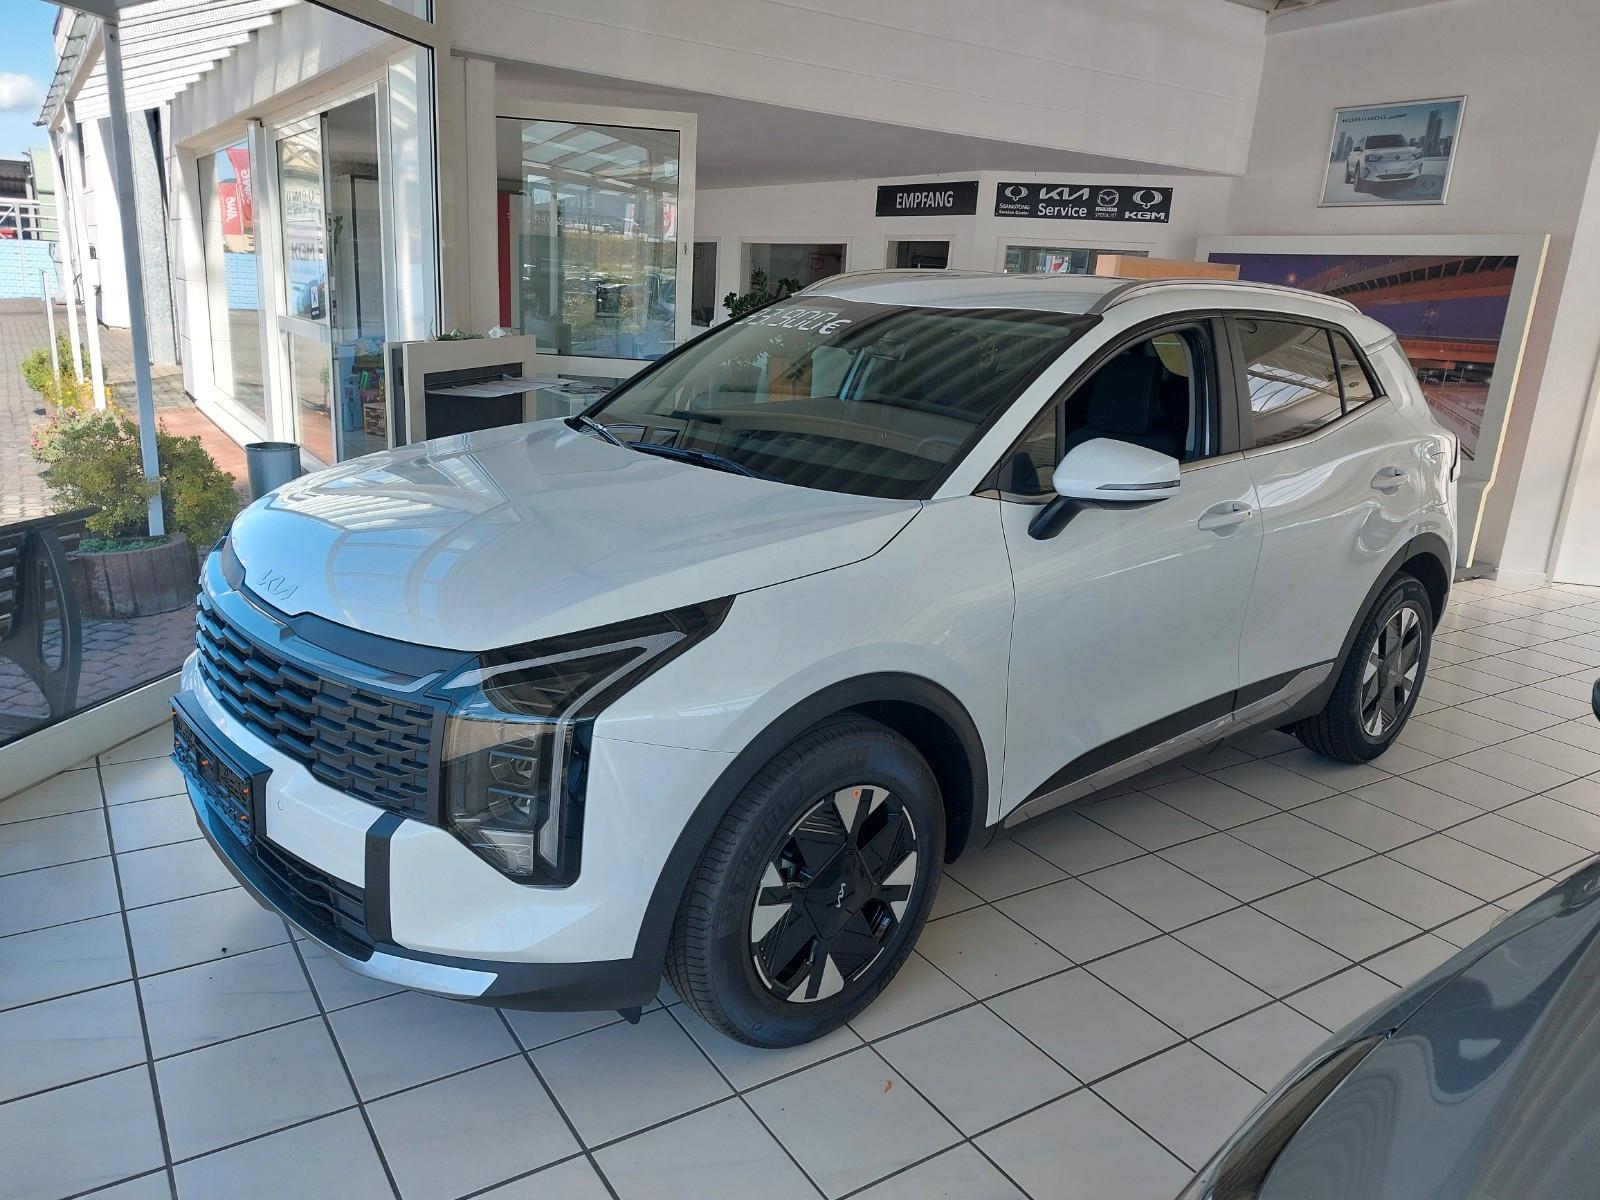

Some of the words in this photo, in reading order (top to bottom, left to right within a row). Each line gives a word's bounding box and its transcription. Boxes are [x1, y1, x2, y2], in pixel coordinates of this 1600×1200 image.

[896, 190, 954, 209] EMPFANG
[1039, 186, 1090, 200] KIA
[1037, 202, 1088, 217] Service
[1124, 210, 1166, 220] KGM
